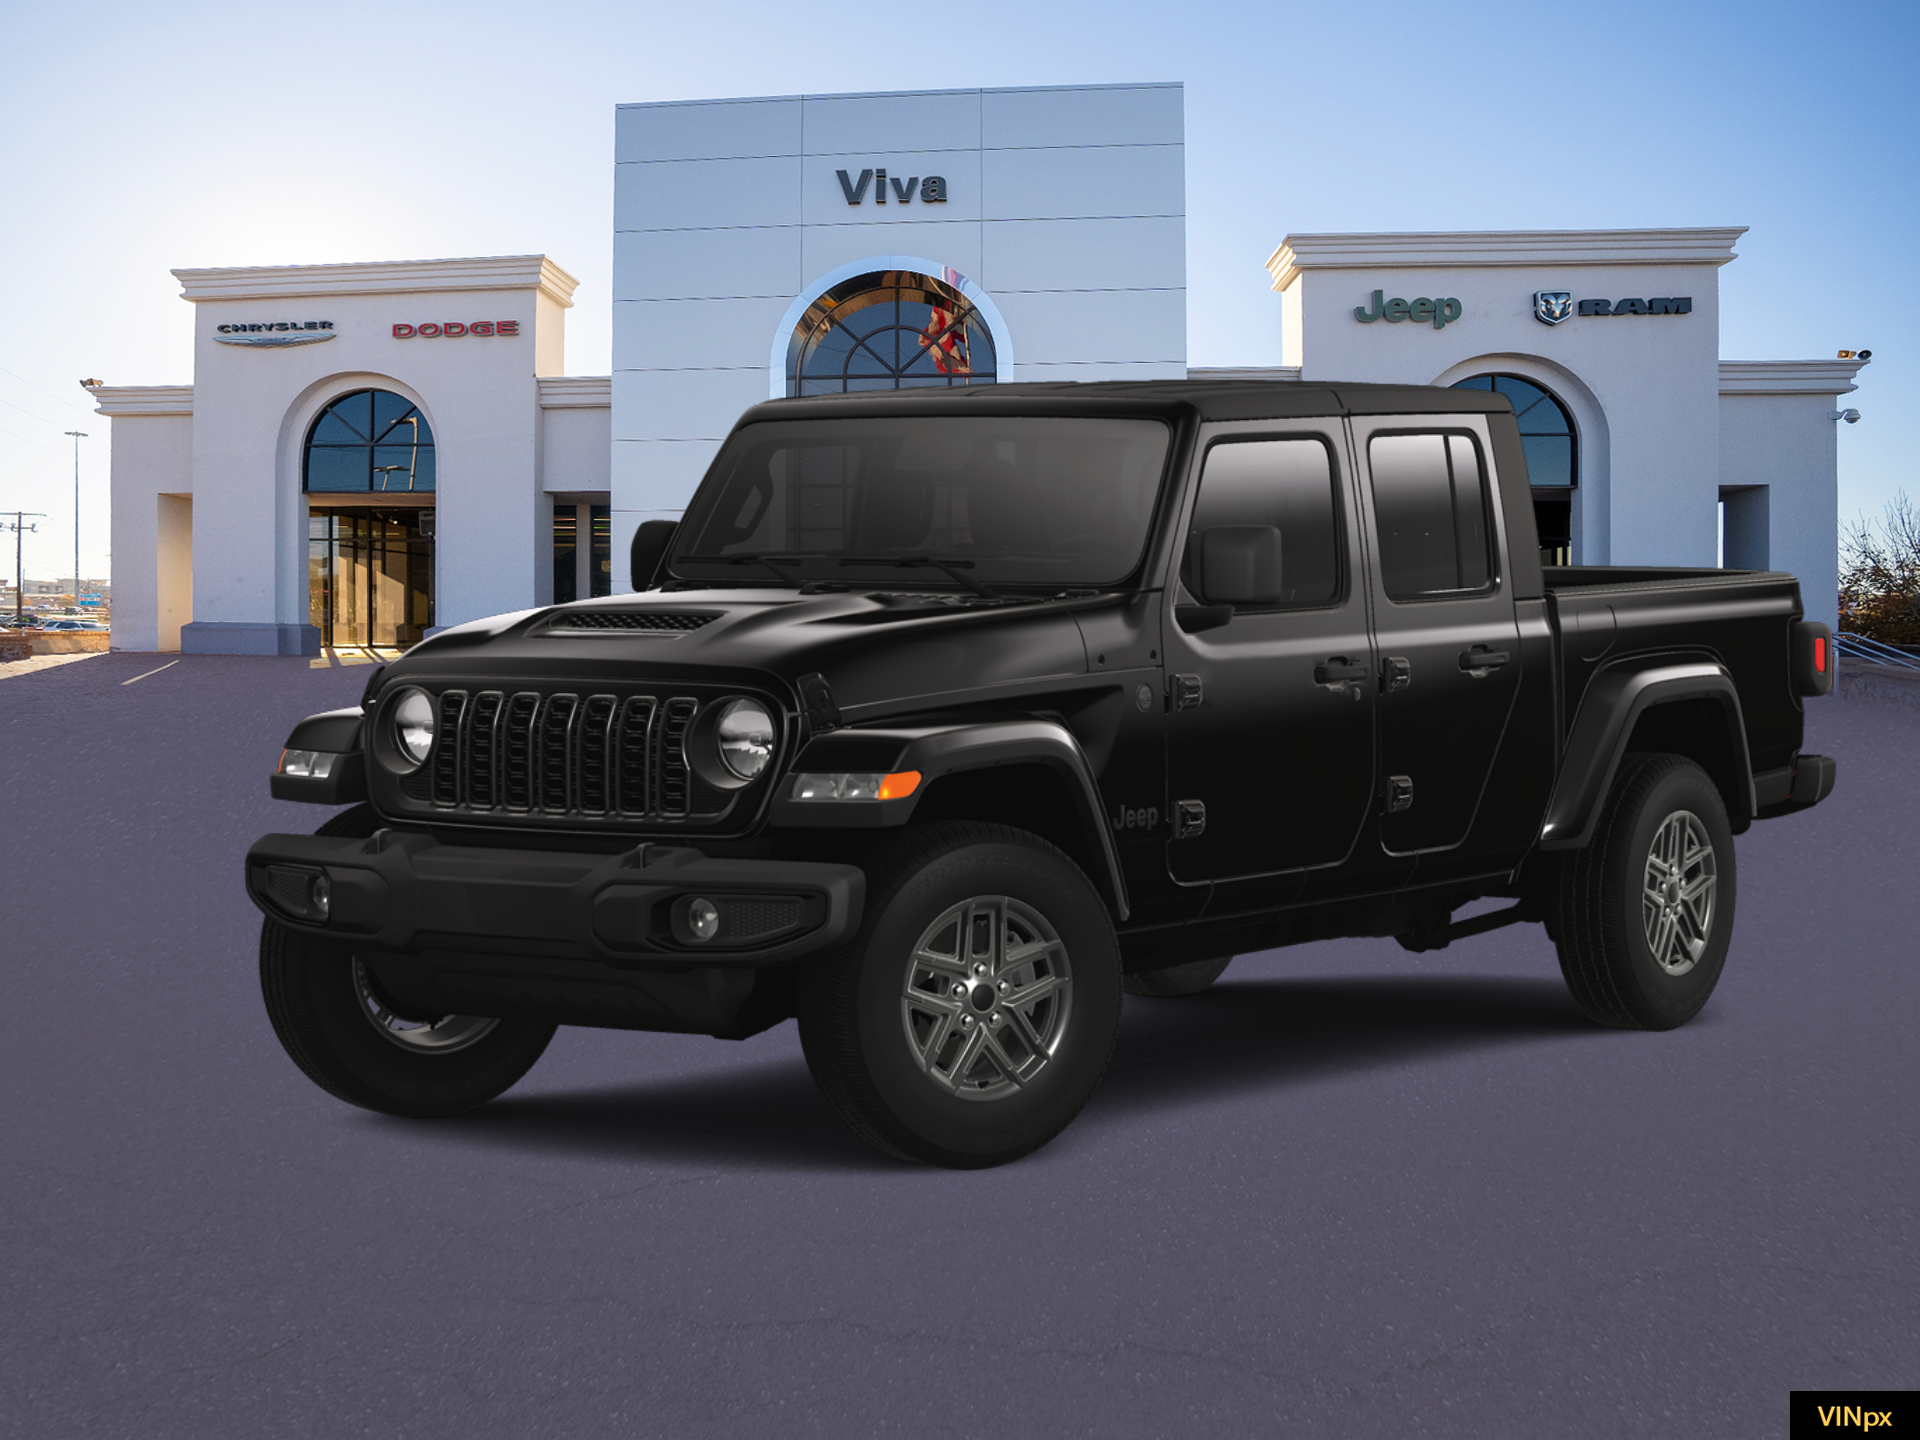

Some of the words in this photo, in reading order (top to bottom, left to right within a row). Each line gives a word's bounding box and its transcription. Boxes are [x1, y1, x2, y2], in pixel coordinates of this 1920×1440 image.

[835, 168, 947, 205] Viva
[1354, 289, 1463, 329] Jeep
[1578, 296, 1693, 316] RAM
[217, 320, 334, 334] CHRYSLER
[392, 320, 520, 339] DODGE
[1112, 804, 1159, 831] Jeep
